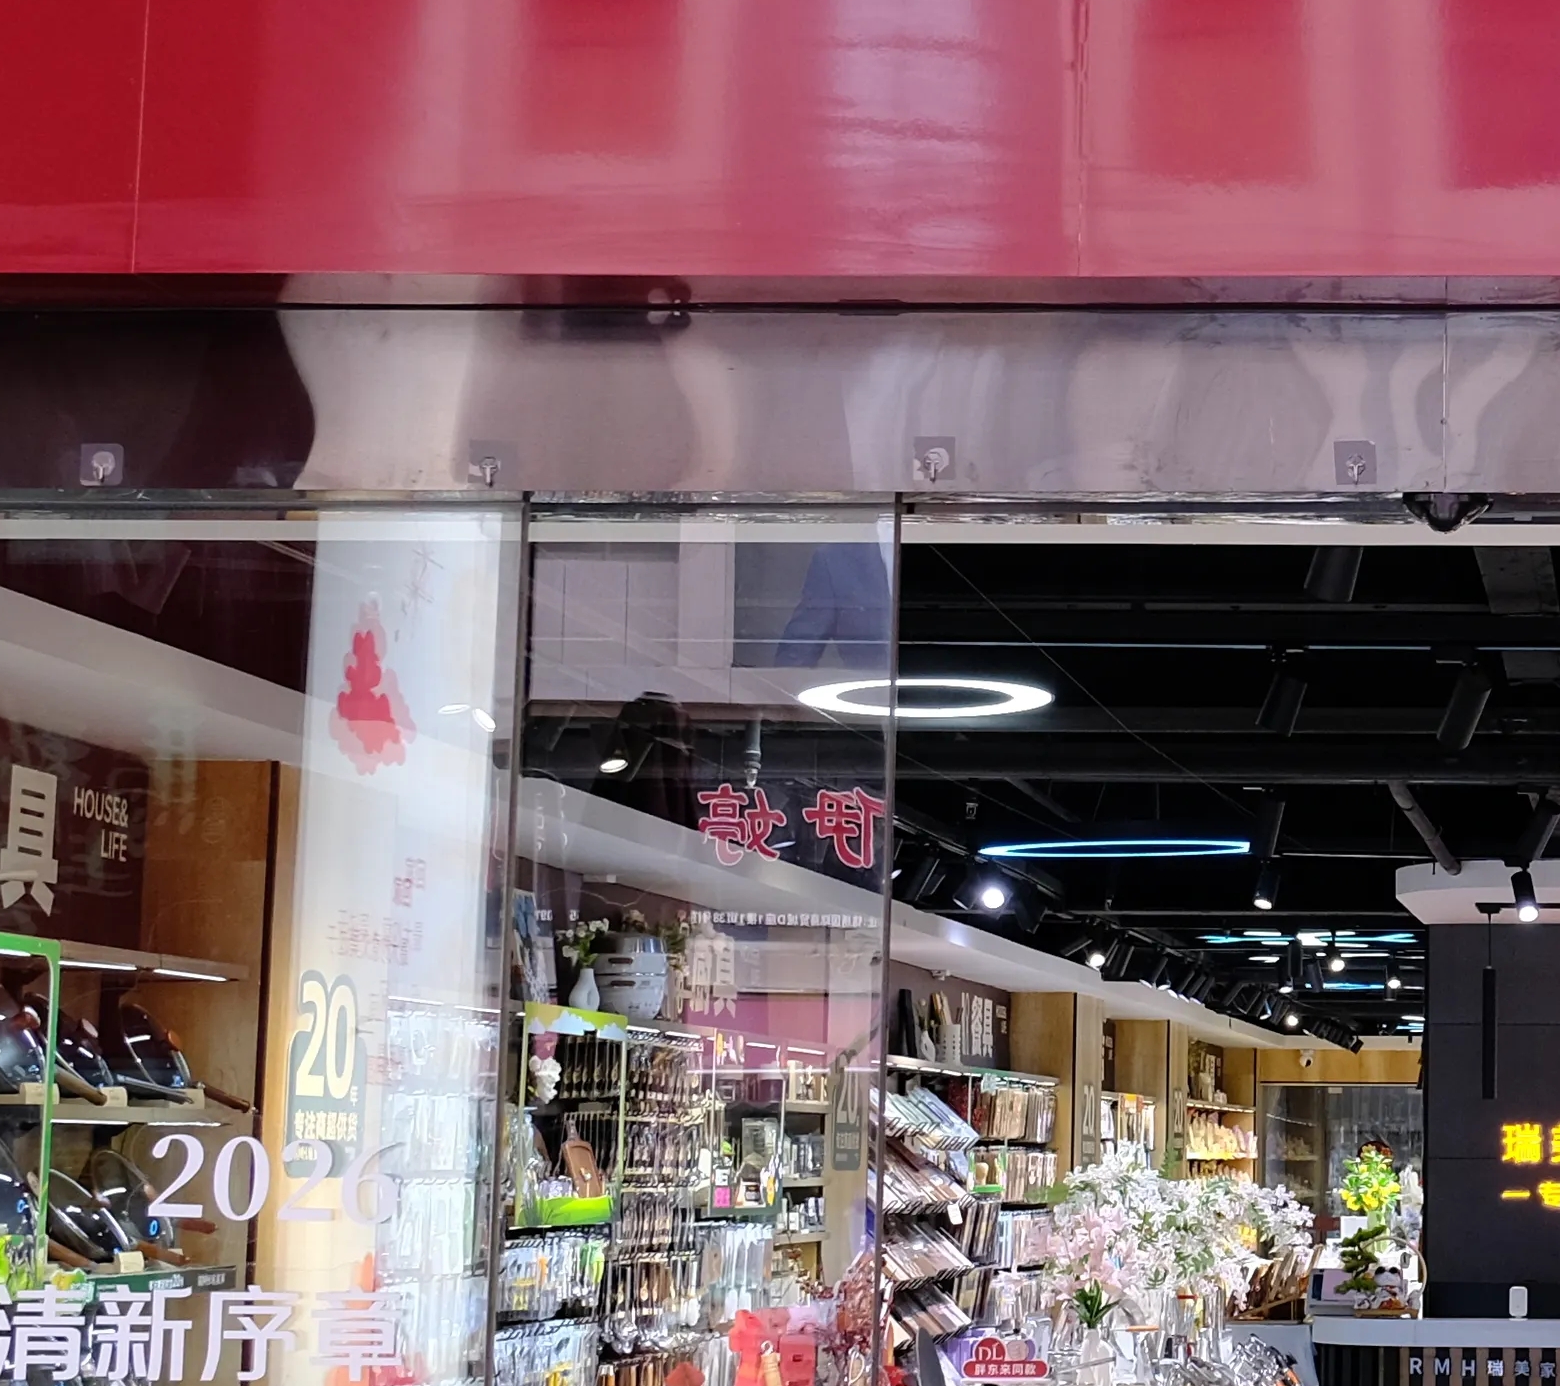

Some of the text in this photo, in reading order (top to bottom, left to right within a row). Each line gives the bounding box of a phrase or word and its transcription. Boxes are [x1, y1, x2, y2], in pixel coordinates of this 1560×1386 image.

[73, 787, 129, 827] HOUSE&
[100, 830, 128, 862] LIFE
[294, 1109, 358, 1142] 专注商超供货
[148, 1132, 407, 1226] 2026
[974, 1363, 1038, 1376] 胖东来同款
[1408, 1357, 1557, 1380] RMH 瑞美家
